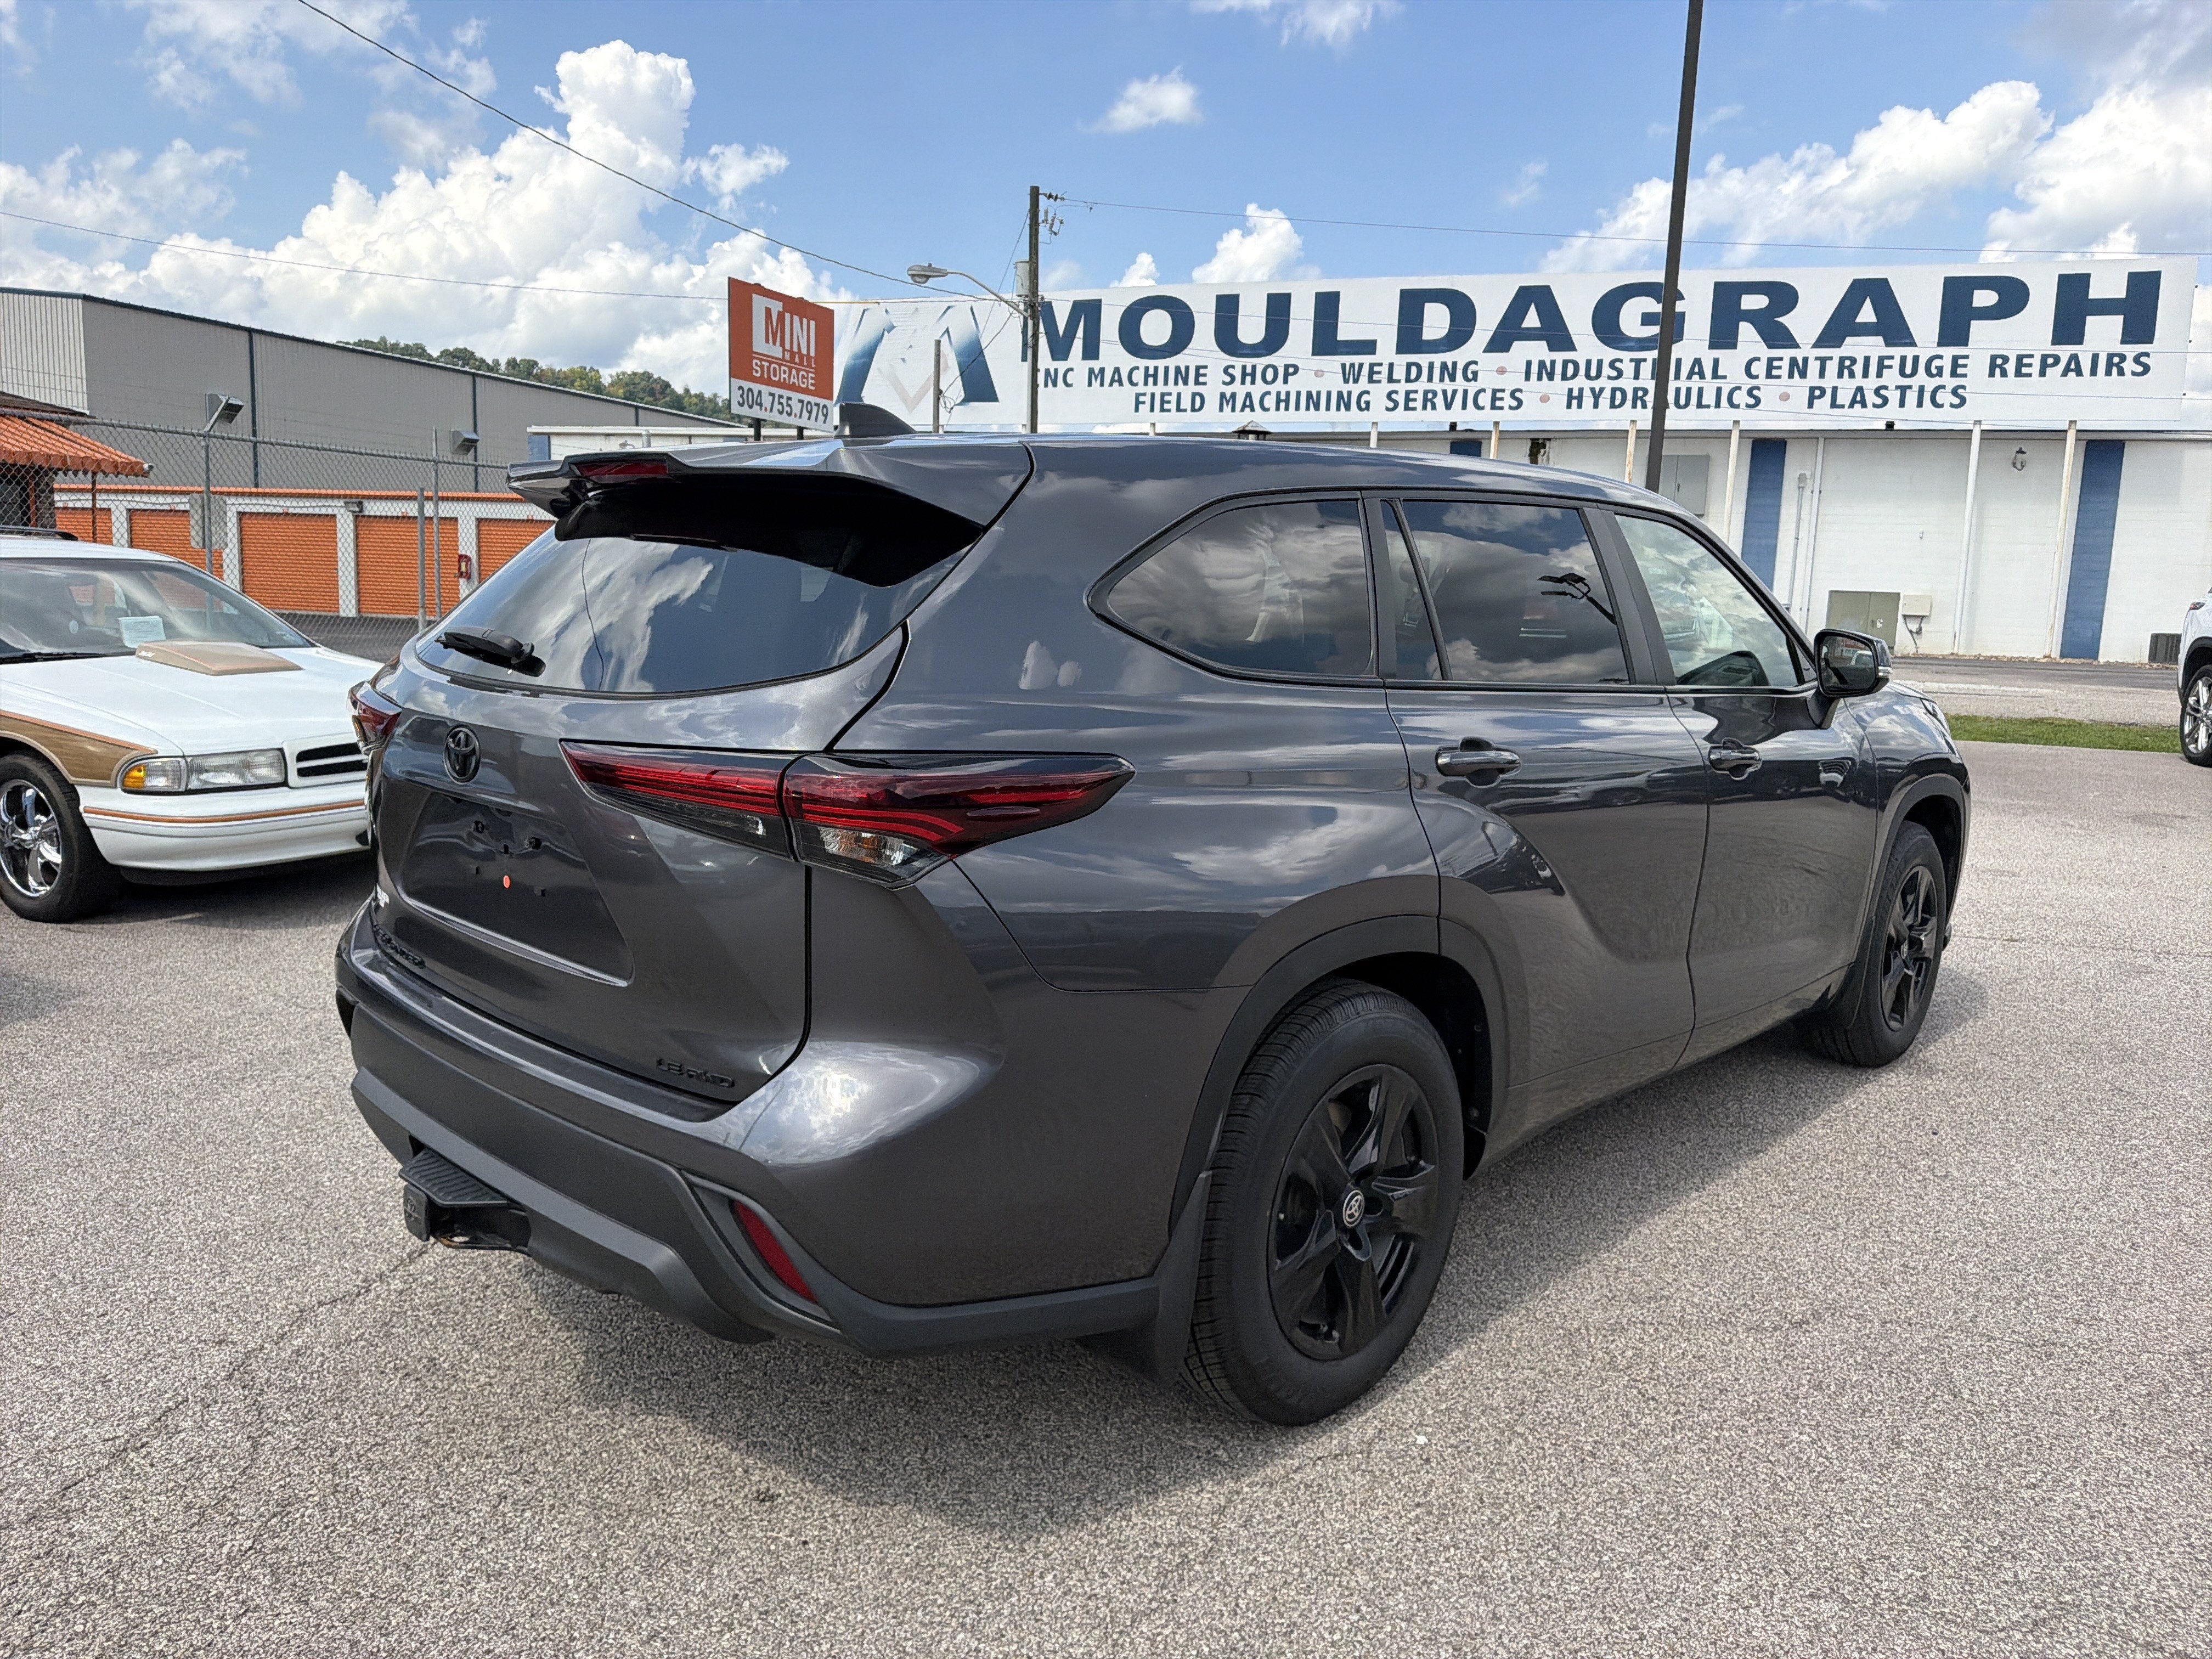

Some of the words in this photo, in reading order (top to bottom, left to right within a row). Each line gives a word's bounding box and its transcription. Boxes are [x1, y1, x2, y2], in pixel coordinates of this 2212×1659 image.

[752, 294, 815, 358] MINI
[1021, 270, 2162, 363] MOULDAGRAPH
[752, 359, 815, 390] STORAGE
[785, 349, 815, 368] MALL
[1037, 367, 1074, 388] NC
[1087, 365, 1208, 387] MACHINE
[1222, 363, 1300, 386] SHOP
[1340, 360, 1479, 385] WELDING
[1744, 354, 1970, 380] CENTRIFUGE
[1988, 352, 2151, 378] REPAIRS
[737, 385, 828, 425] 304.755.7979
[1134, 392, 1205, 413] FIELD
[1218, 390, 1370, 413] MACHINING
[1385, 388, 1523, 412] SERVICES
[1566, 386, 1762, 410] HYDRULICS
[1807, 385, 1967, 409] PLASTICS
